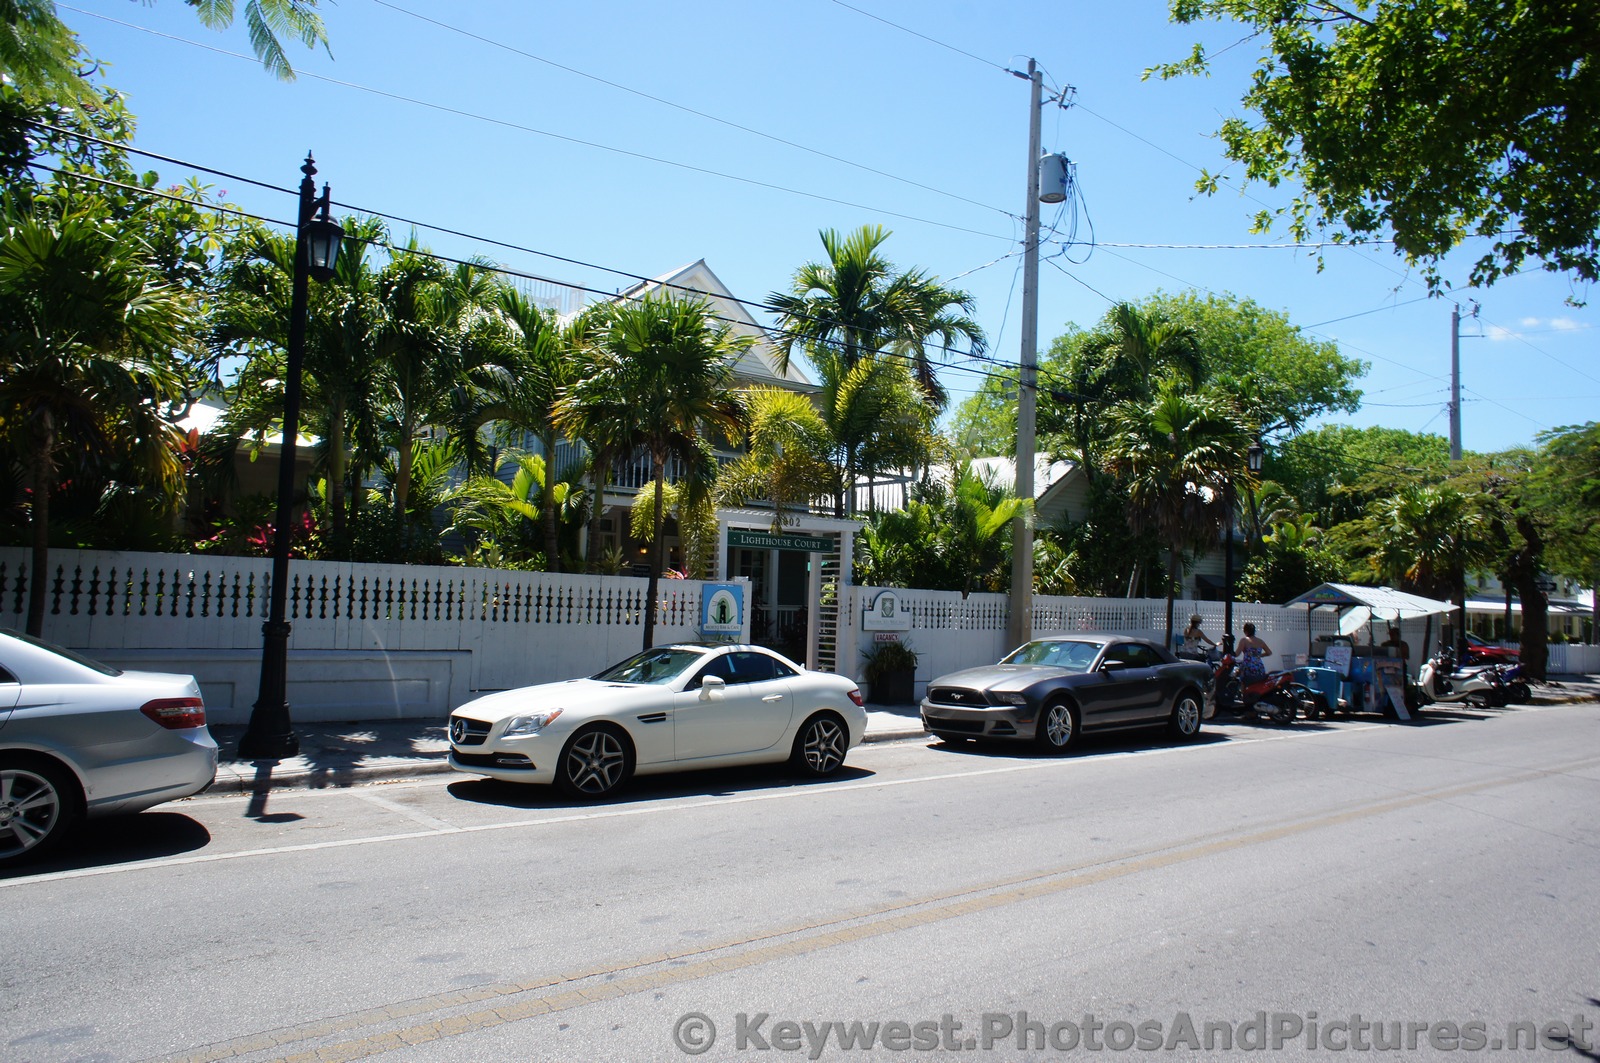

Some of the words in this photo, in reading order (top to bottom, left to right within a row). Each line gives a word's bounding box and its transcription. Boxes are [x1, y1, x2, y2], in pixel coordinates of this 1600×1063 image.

[741, 535, 791, 547] LIGHTHOUSE
[794, 538, 821, 549] COURT
[876, 633, 899, 641] VACANCY
